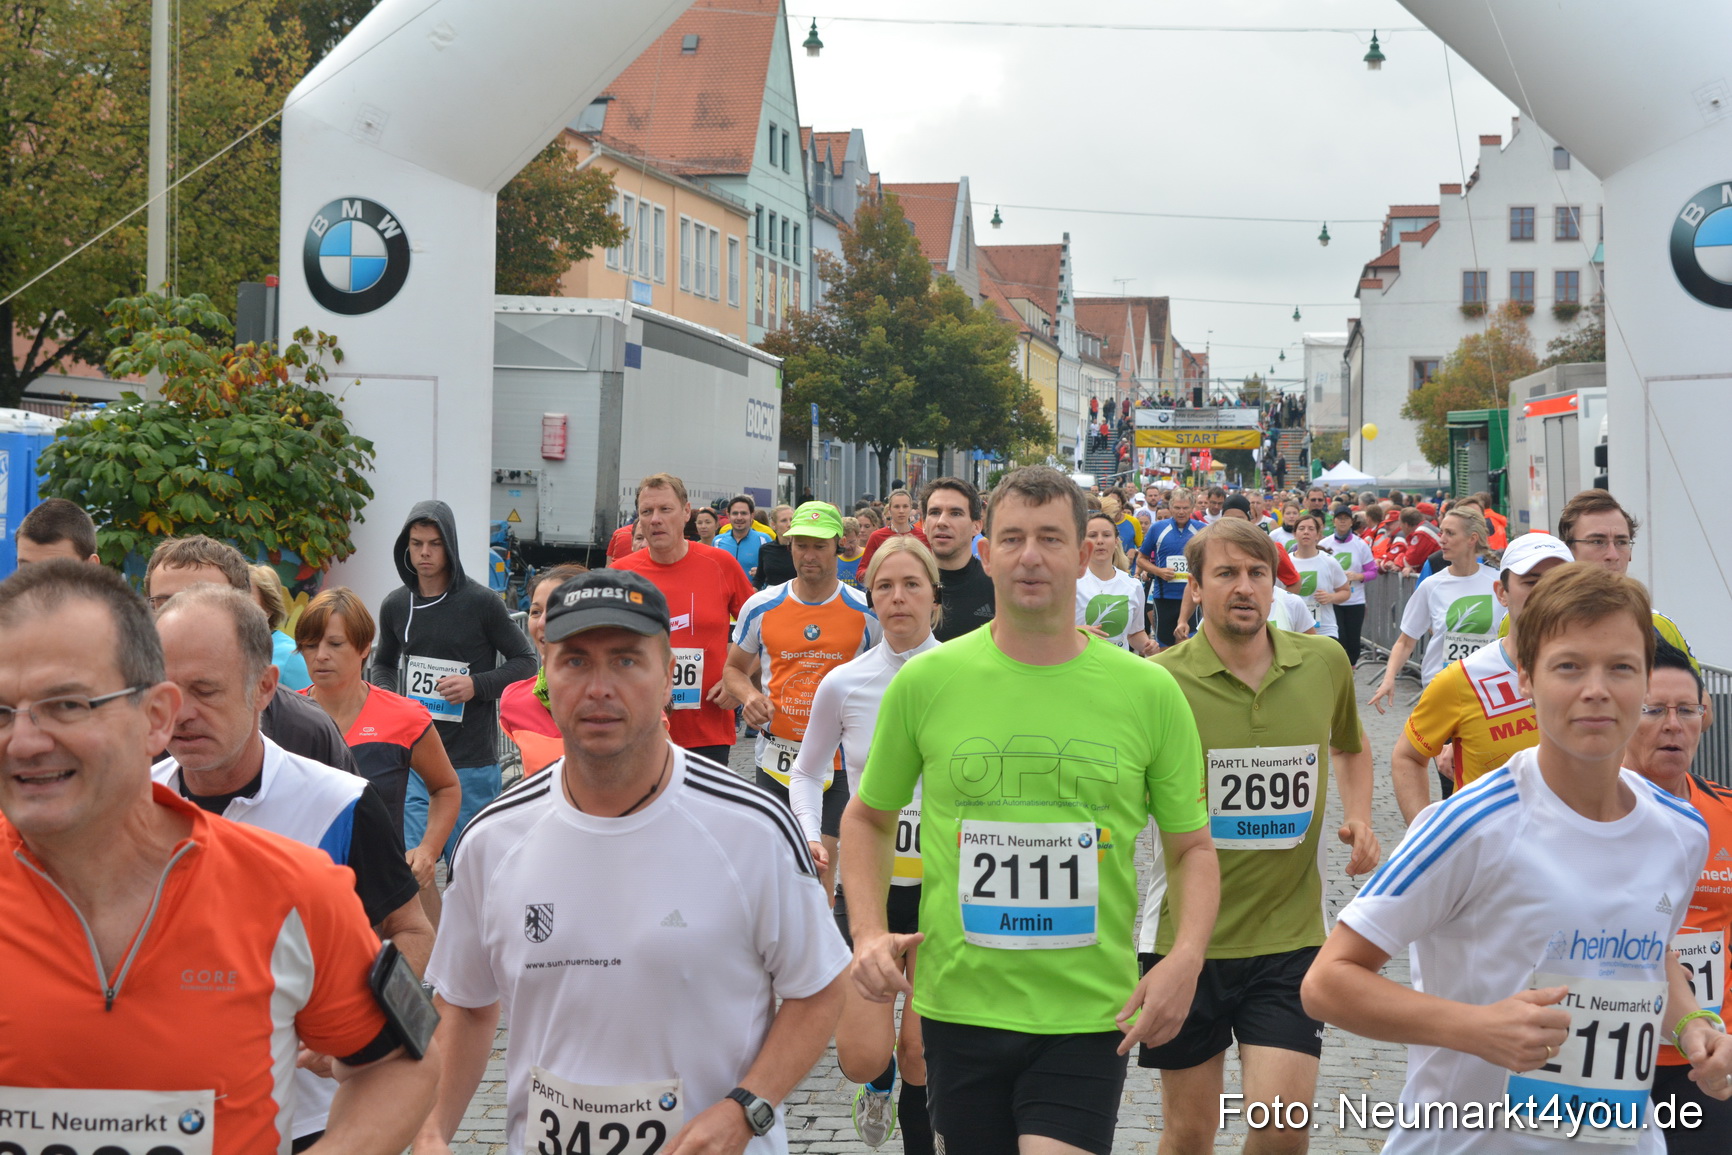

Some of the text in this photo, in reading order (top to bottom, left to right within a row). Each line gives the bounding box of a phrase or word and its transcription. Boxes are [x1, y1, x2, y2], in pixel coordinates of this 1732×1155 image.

[311, 200, 402, 239] BMW
[745, 398, 774, 441] BOCK
[1176, 433, 1220, 444] START
[563, 587, 624, 606] mares
[780, 650, 843, 660] SportScheck
[409, 661, 458, 673] PARTL Neumarkt
[1210, 756, 1302, 769] PARTL Neumarkt
[1220, 770, 1310, 811] 2696
[1237, 820, 1295, 838] Stephan
[963, 833, 1072, 847] PARTL Neumarkt
[972, 852, 1079, 900] 2111
[1000, 913, 1053, 931] Armin
[1569, 928, 1663, 961] heinloth
[525, 957, 622, 969] www.sun.nuernberg.de
[181, 968, 238, 985] GORE
[1590, 996, 1651, 1013] Neumarkt
[532, 1080, 652, 1113] PARTL Neumarkt
[52, 1112, 167, 1132] Neumarkt
